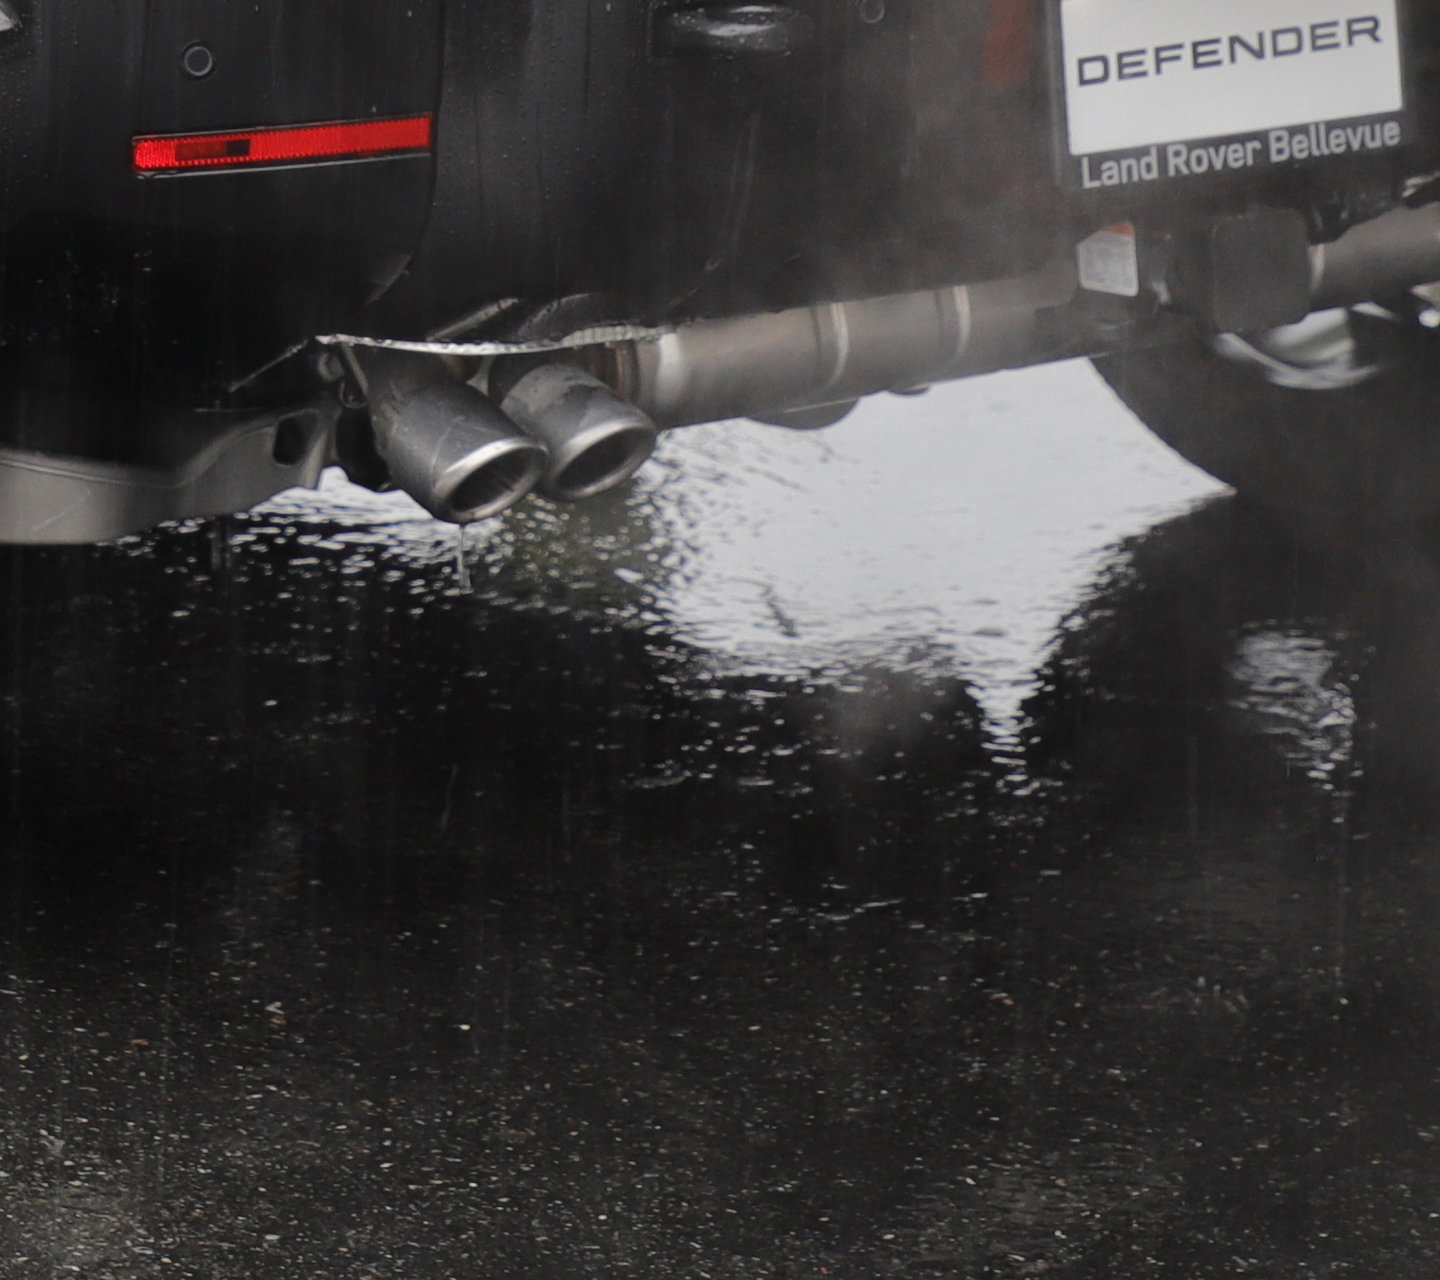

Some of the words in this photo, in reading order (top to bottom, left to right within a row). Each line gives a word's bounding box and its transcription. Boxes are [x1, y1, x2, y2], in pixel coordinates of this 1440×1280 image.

[1076, 14, 1383, 87] DEFENDER
[1080, 144, 1160, 189] Land
[1166, 138, 1262, 176] Rover
[1268, 120, 1402, 163] Bellevue
